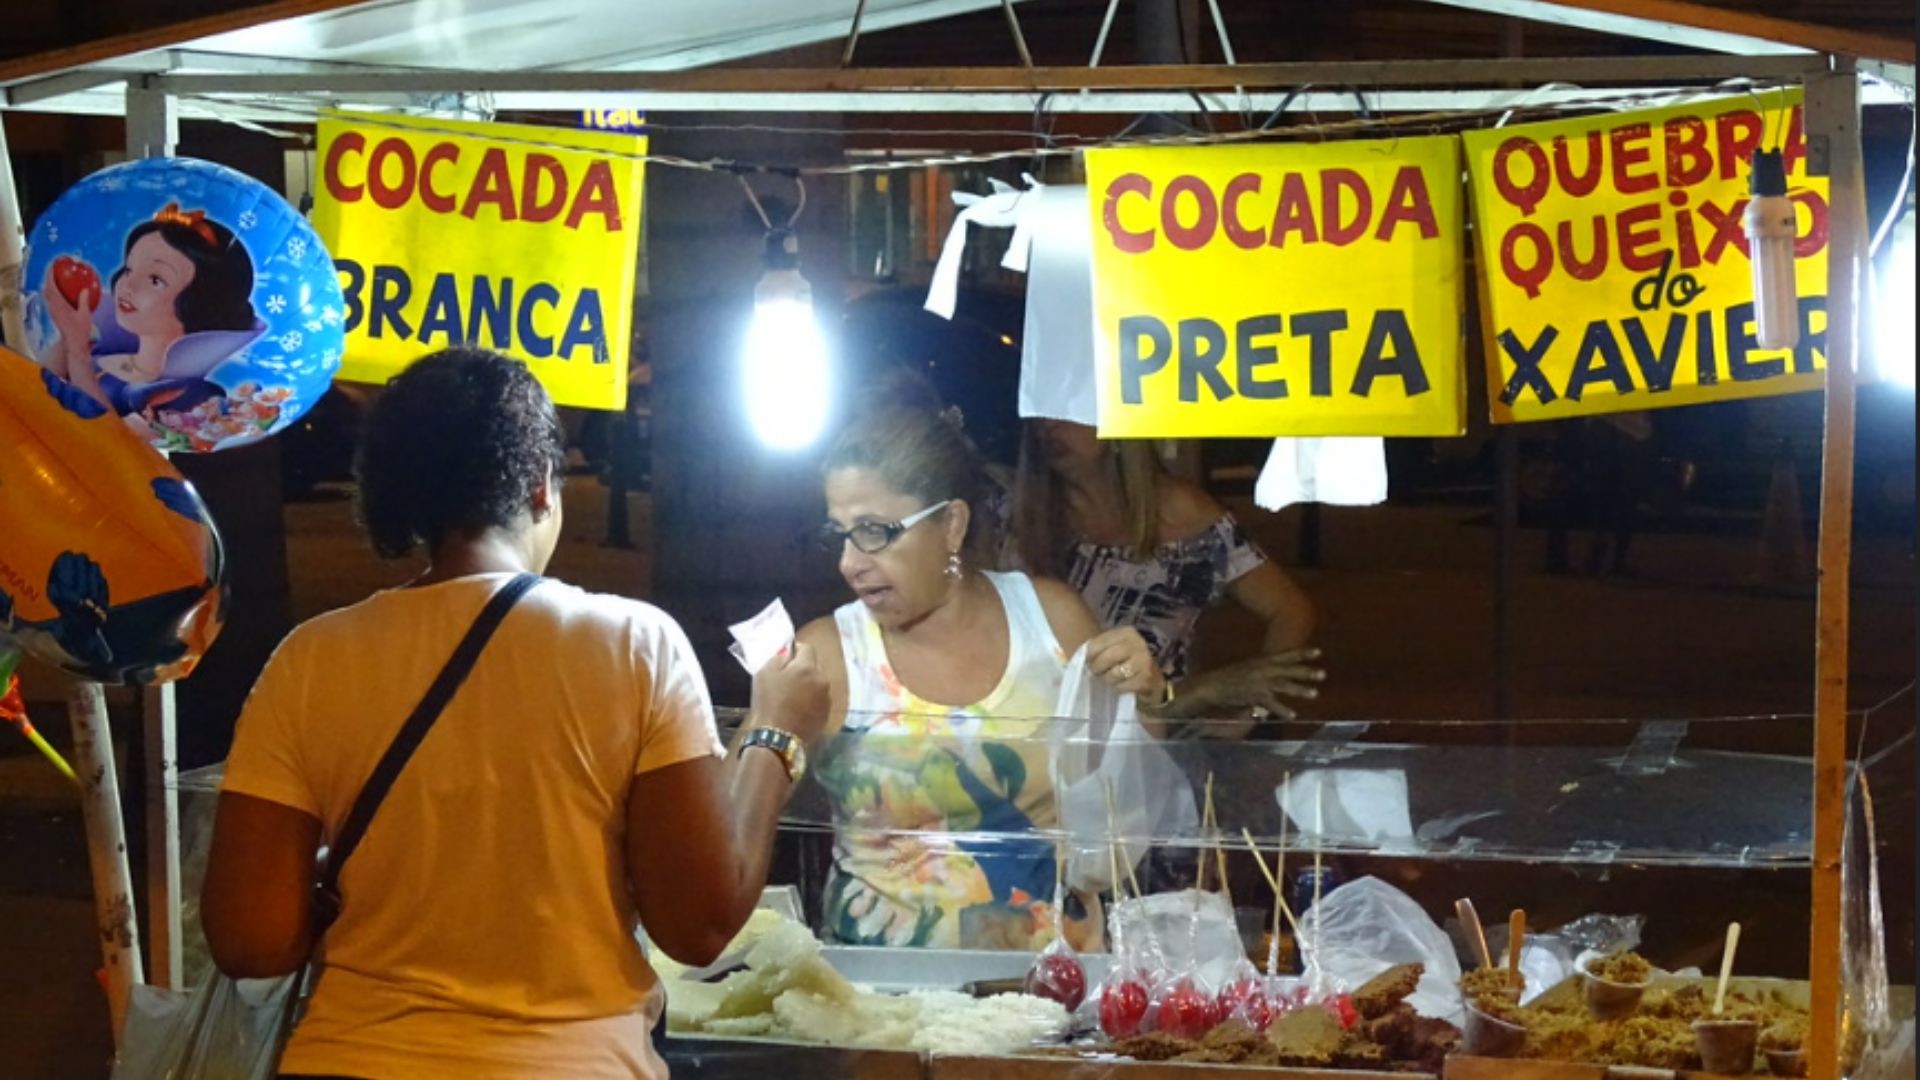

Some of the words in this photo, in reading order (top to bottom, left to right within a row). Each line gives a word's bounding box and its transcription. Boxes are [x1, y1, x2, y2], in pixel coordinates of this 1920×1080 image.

[324, 132, 623, 232] COCADA
[1102, 166, 1440, 253] COCADA
[333, 258, 610, 364] BRANCA
[1631, 248, 1706, 311] do
[1119, 309, 1431, 404] PRETA
